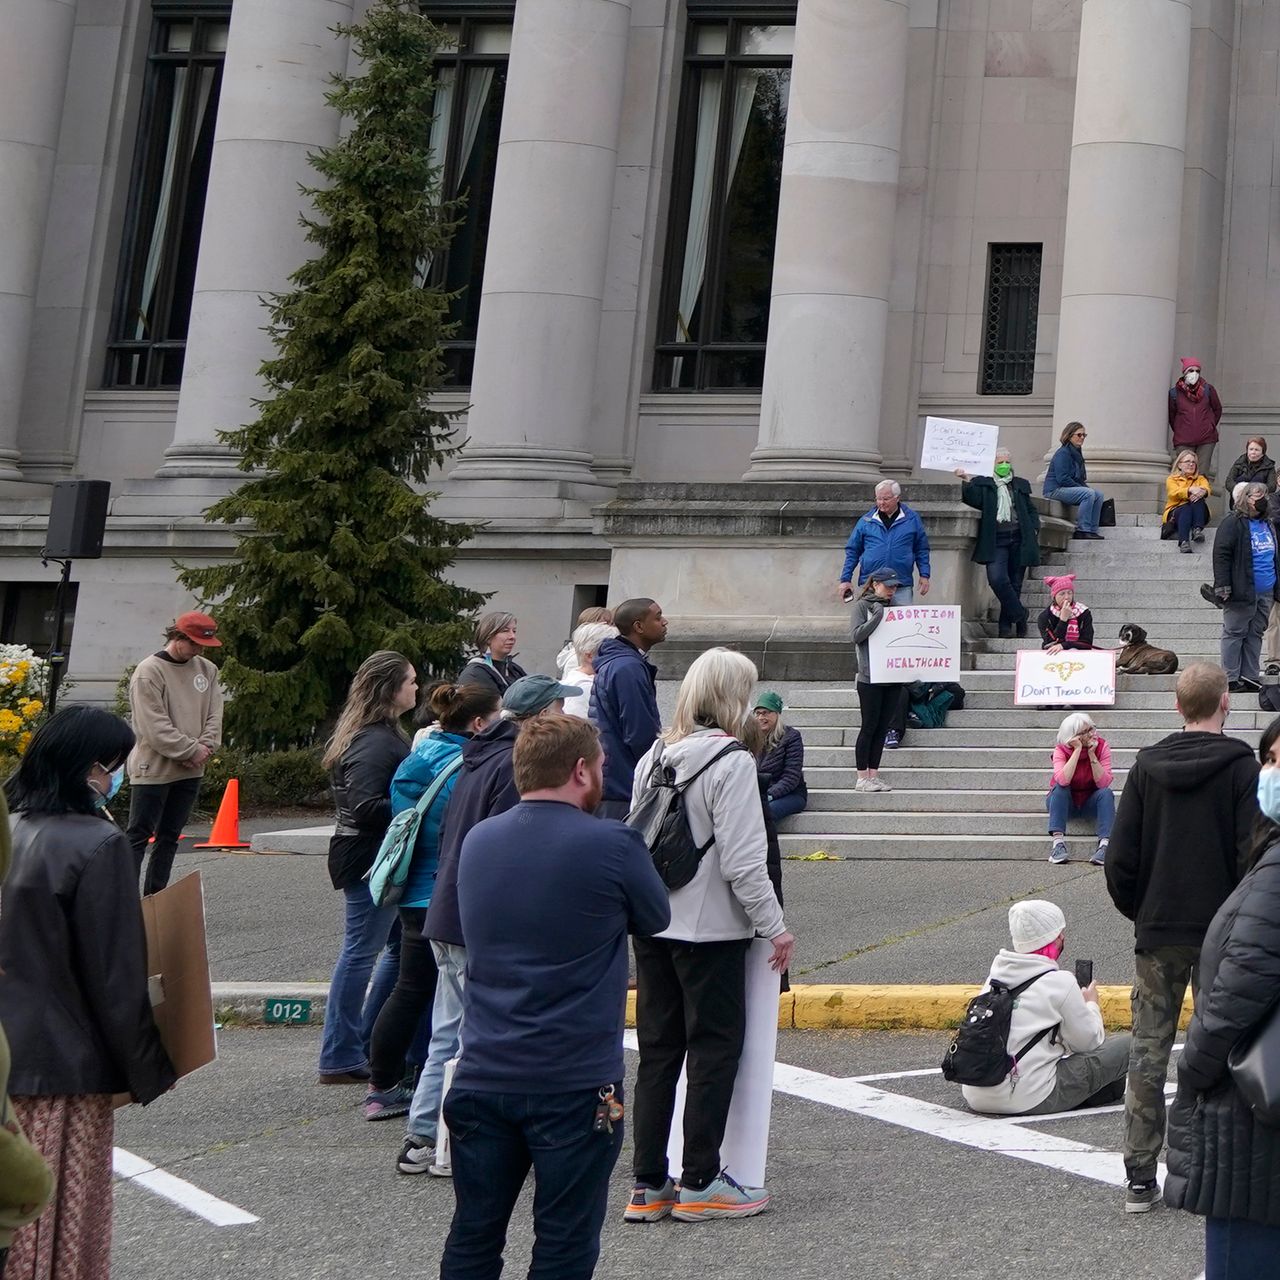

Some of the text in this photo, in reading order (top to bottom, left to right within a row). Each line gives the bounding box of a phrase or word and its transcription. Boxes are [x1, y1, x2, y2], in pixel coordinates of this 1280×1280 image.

[885, 609, 955, 623] ABORTION
[928, 625, 941, 634] IS
[886, 657, 952, 669] HEALTHCARE
[272, 1003, 302, 1019] 012
